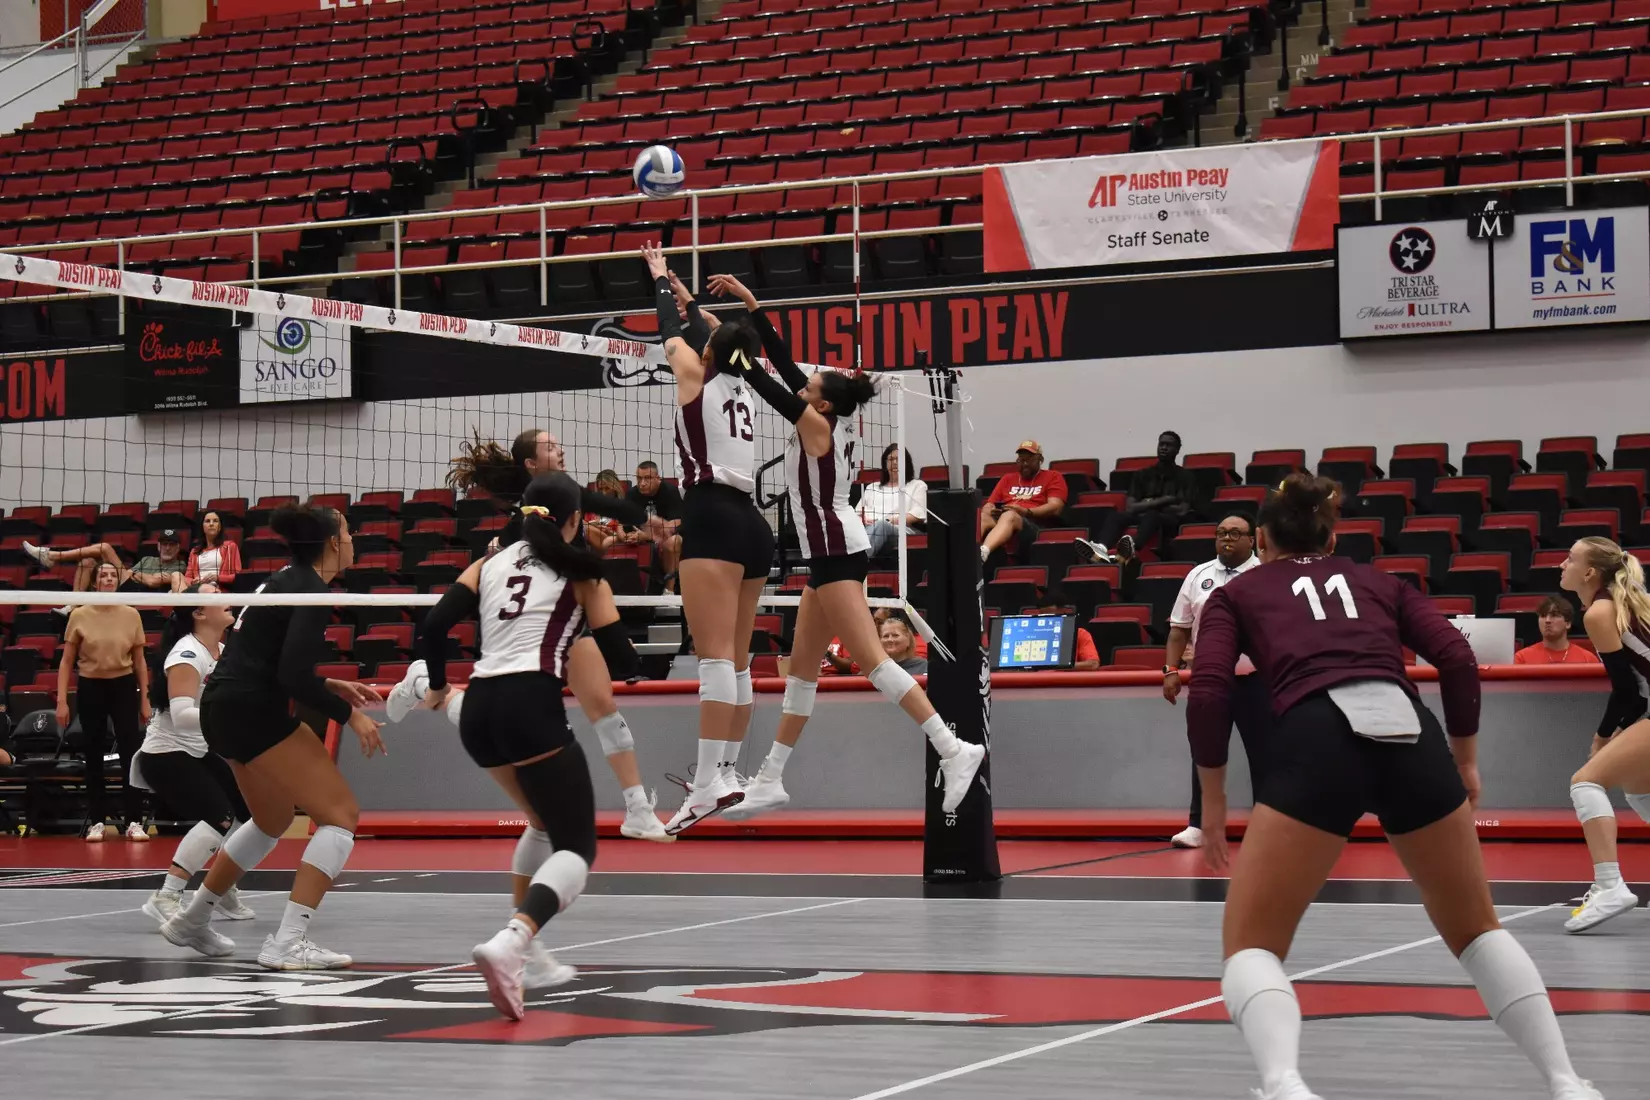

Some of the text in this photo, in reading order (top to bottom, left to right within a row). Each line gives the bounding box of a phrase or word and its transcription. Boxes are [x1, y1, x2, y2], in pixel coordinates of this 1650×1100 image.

[1128, 168, 1229, 191] Austin Peay
[1128, 188, 1228, 206] State University
[1477, 215, 1504, 237] M
[1107, 229, 1210, 249] Staff Senate
[1530, 216, 1615, 278] F&M
[58, 262, 122, 289] AUSTIN PEAY
[1391, 275, 1435, 288] TRI STAR
[1531, 276, 1615, 295] BANK
[192, 280, 250, 306] AUSTIN PEAY
[1387, 286, 1440, 299] BEVERAGE
[311, 297, 364, 321] AUSTIN PEAY
[1356, 302, 1471, 319] Michelob ULTRA
[1533, 304, 1617, 320] myfmbank.com
[420, 313, 468, 334] AUSTIN PEAY
[948, 292, 1069, 363] PEAY
[1401, 321, 1453, 329] RESPONSIBLY
[518, 326, 560, 347] AUSTIN PEAY
[607, 338, 647, 358] AUSTIN PEAY
[255, 357, 336, 382] SANGO
[270, 381, 323, 392] EYE CARE
[722, 399, 754, 442] 13
[498, 575, 532, 620] 3
[1292, 573, 1359, 620] 11
